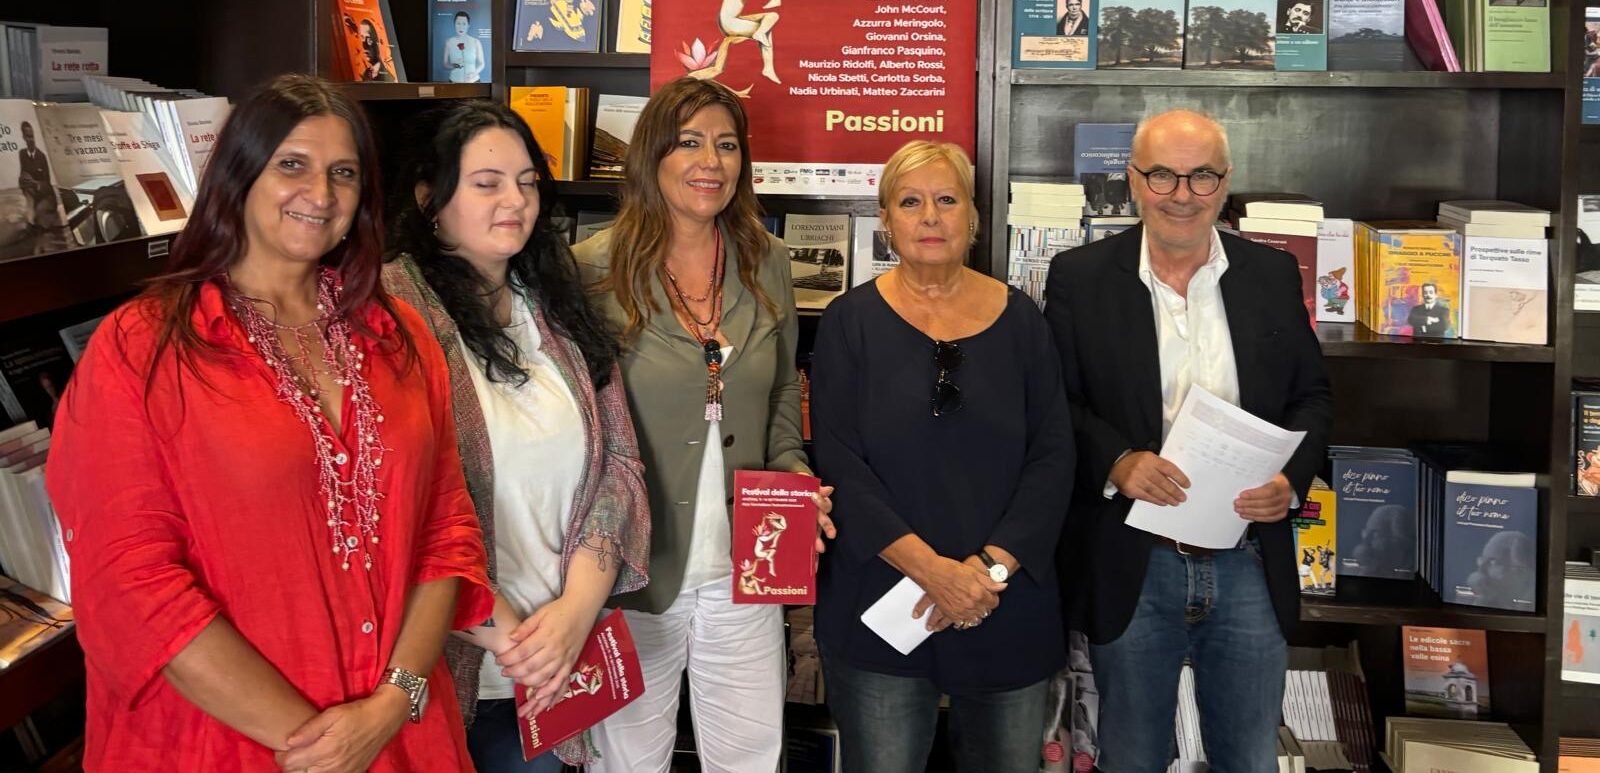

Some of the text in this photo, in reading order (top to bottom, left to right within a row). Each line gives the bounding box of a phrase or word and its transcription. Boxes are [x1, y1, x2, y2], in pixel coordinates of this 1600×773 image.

[874, 5, 947, 15] John McCourt,
[853, 18, 947, 29] Azzurra Meringolo,
[866, 32, 947, 42] Giovanni Orsina,
[841, 45, 946, 57] Gianfranco Pasquino,
[52, 61, 62, 71] La
[799, 60, 946, 70] Maurizio Ridolfi, Alberto Rossi,
[808, 73, 946, 84] Nicola Sbetti, Carlotta Sorba,
[789, 87, 945, 97] Nadia Urbinati, Matteo Zaccarini
[825, 109, 945, 133] Passioni
[190, 134, 199, 143] La
[74, 146, 108, 155] vacanza
[791, 223, 845, 231] LORENZO VIANI
[1478, 254, 1509, 262] Torquato
[1510, 255, 1530, 263] Tasso
[742, 487, 770, 496] Festival
[771, 488, 789, 496] della
[763, 585, 808, 596] Passioni
[605, 626, 621, 662] Festival
[1409, 635, 1418, 643] Le
[1420, 636, 1448, 645] edicole
[1429, 645, 1452, 653] bassa
[615, 657, 625, 676] della
[619, 677, 629, 700] storia
[527, 714, 543, 750] ssioni
